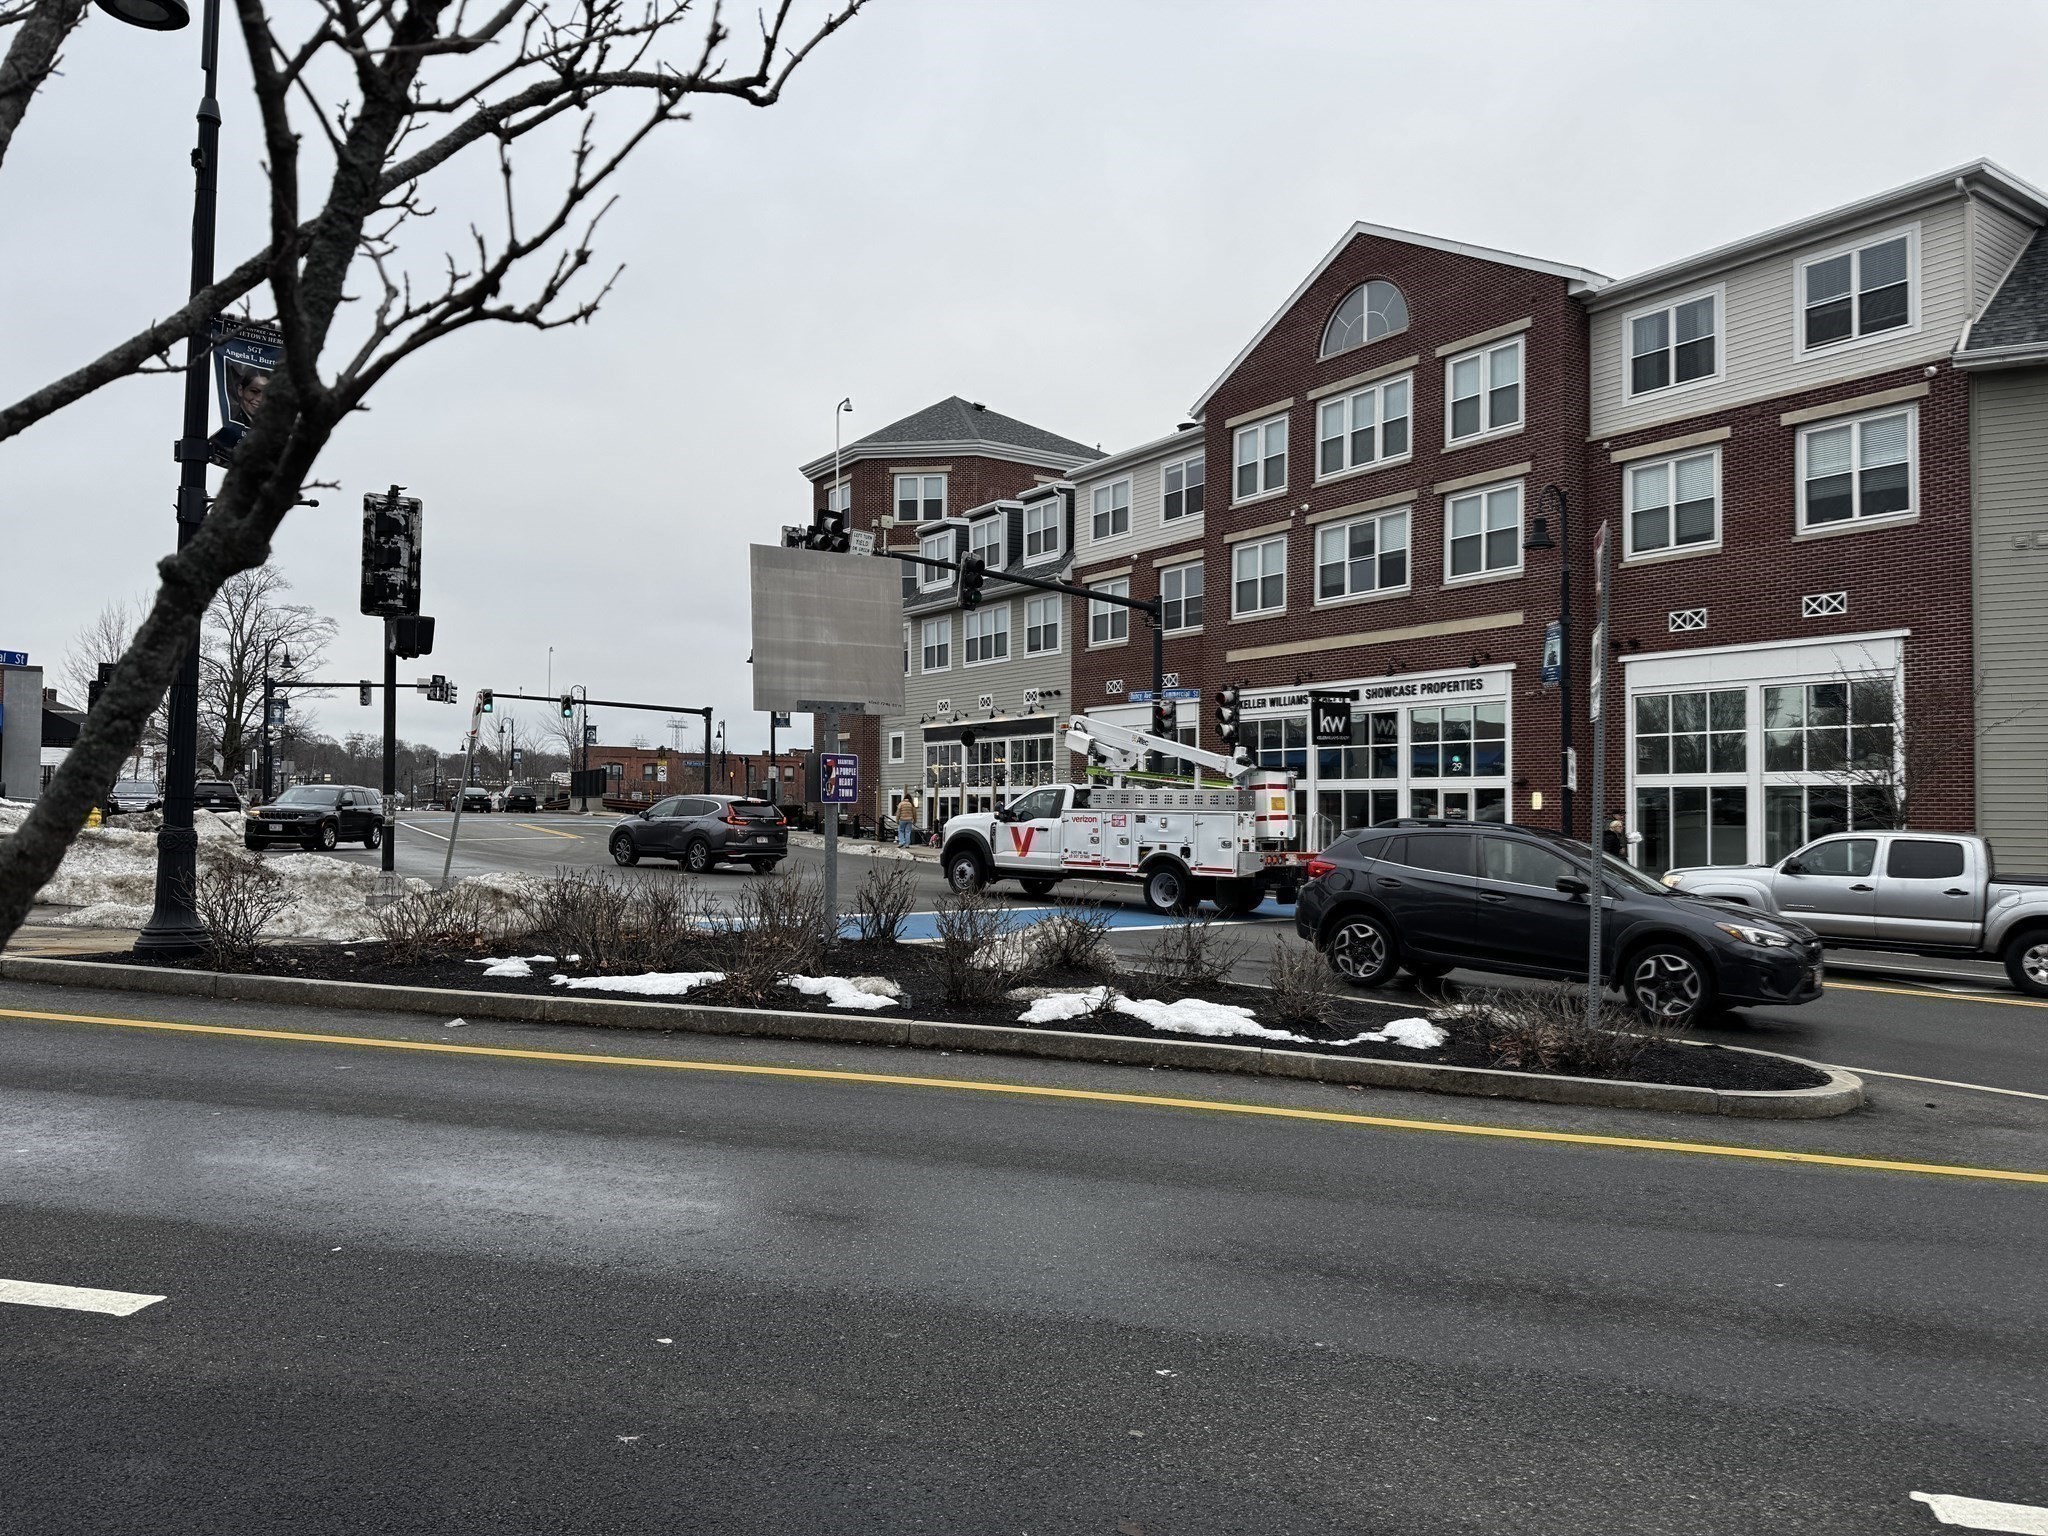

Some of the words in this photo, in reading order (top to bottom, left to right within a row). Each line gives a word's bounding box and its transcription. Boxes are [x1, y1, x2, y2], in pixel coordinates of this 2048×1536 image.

[247, 345, 263, 354] SGT
[225, 348, 250, 360] Angela
[251, 354, 258, 362] L.
[856, 539, 868, 547] YIELD
[15, 653, 24, 664] St
[1240, 698, 1266, 709] KELLER
[1269, 694, 1308, 707] WILLIAMS
[1365, 684, 1417, 699] SHOWCASE
[1420, 678, 1483, 694] PROPERTIES
[1320, 708, 1346, 732] kw
[840, 767, 856, 776] PURPLE
[839, 778, 853, 786] HEART
[839, 789, 853, 797] TOWN
[1071, 815, 1097, 823] verizon
